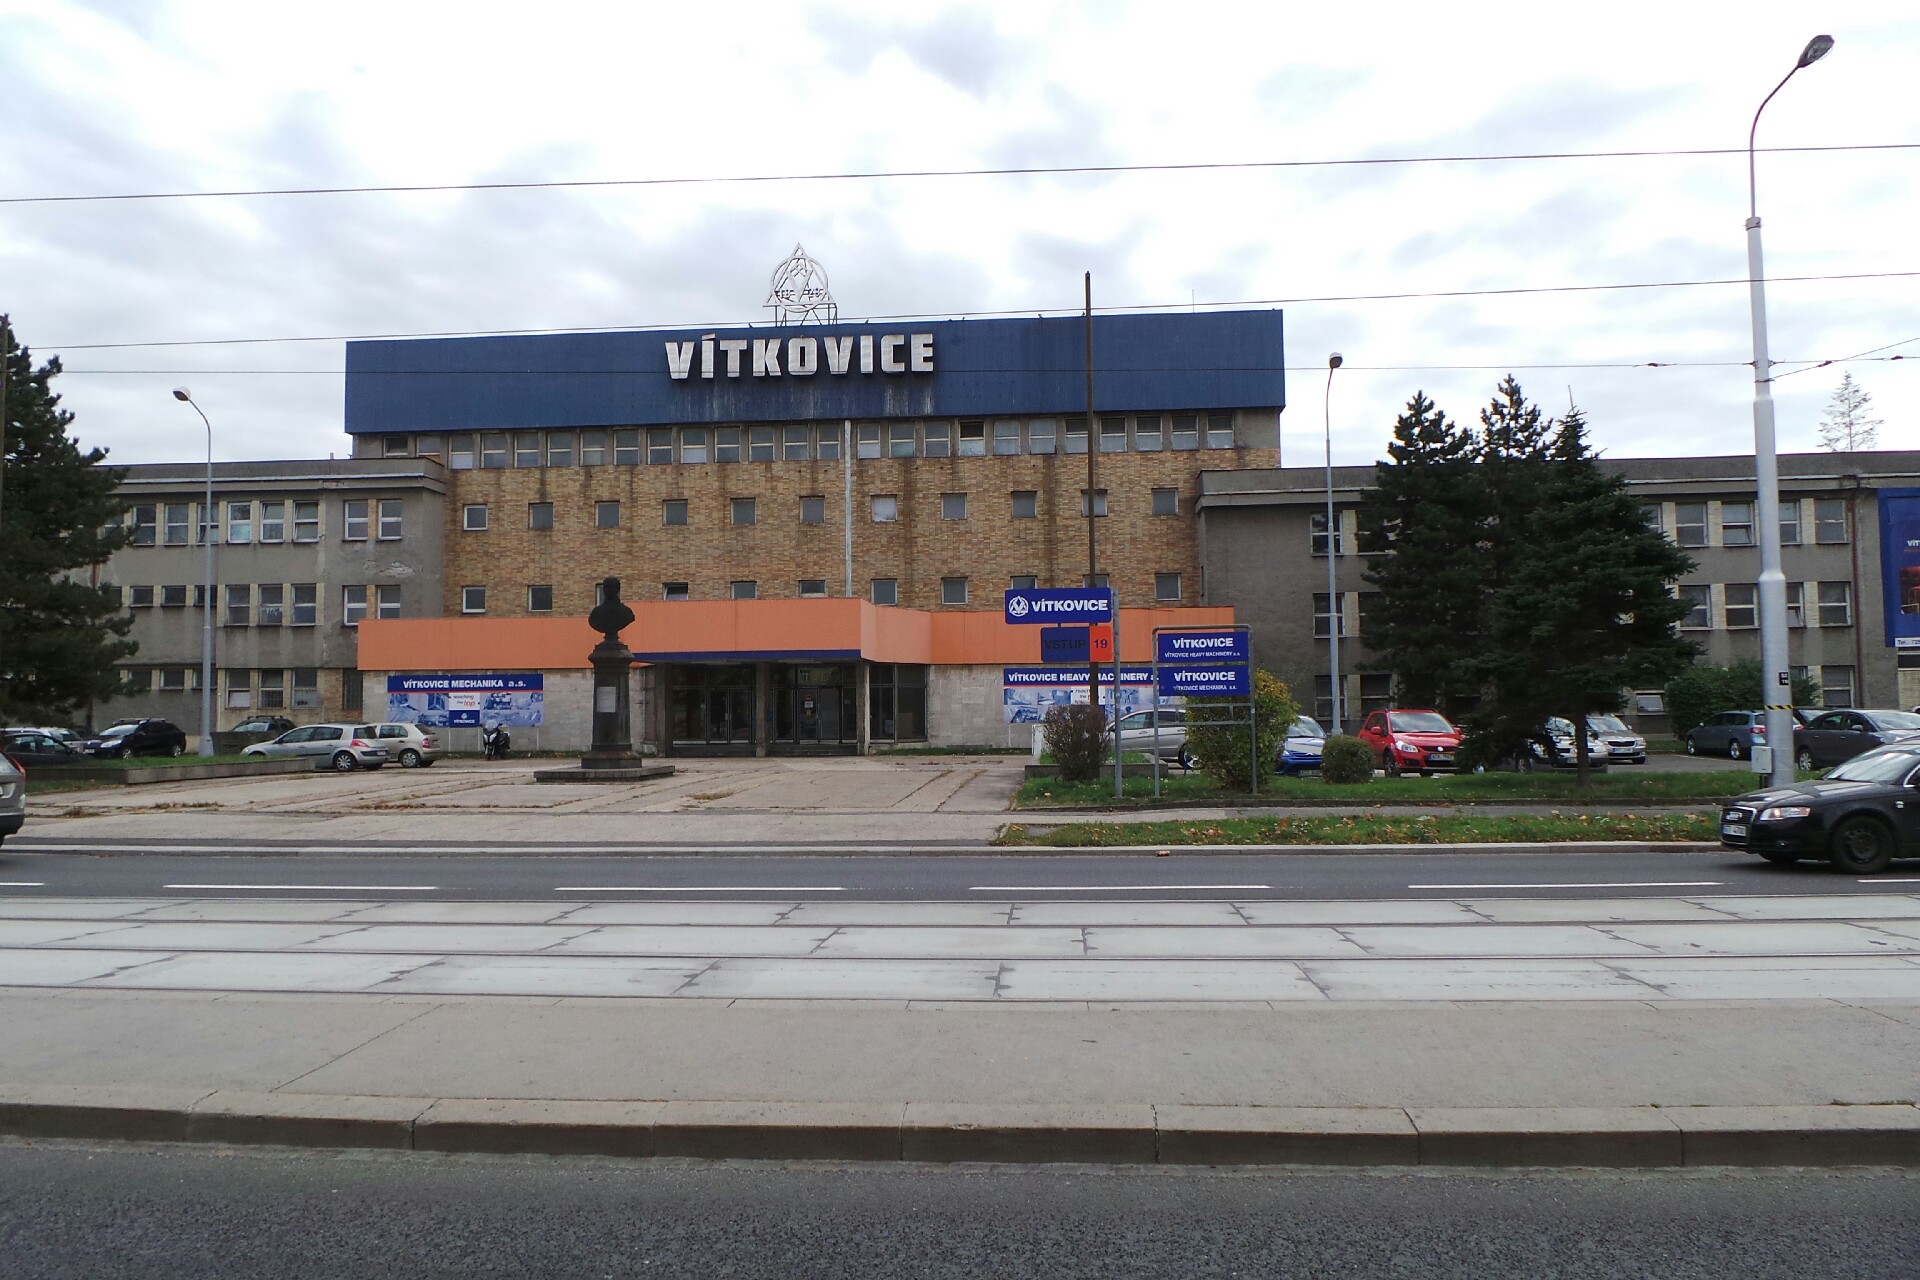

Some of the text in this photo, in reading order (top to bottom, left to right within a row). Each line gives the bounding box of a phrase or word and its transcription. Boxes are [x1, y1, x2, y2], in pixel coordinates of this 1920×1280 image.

[665, 333, 934, 380] VÍTKOVICE
[1031, 598, 1109, 612] VÍTKOVICE
[1044, 638, 1108, 651] VSTUP 19
[1173, 637, 1234, 649] VÍTKOVICE
[1008, 672, 1057, 682] VÍTKOVICE
[1059, 672, 1090, 682] HEAVY
[1098, 672, 1149, 681] ACINERY
[1174, 670, 1236, 682] VÍTKOVICE
[403, 678, 527, 689] VÍTKOVICE MECHANIKA a.s.
